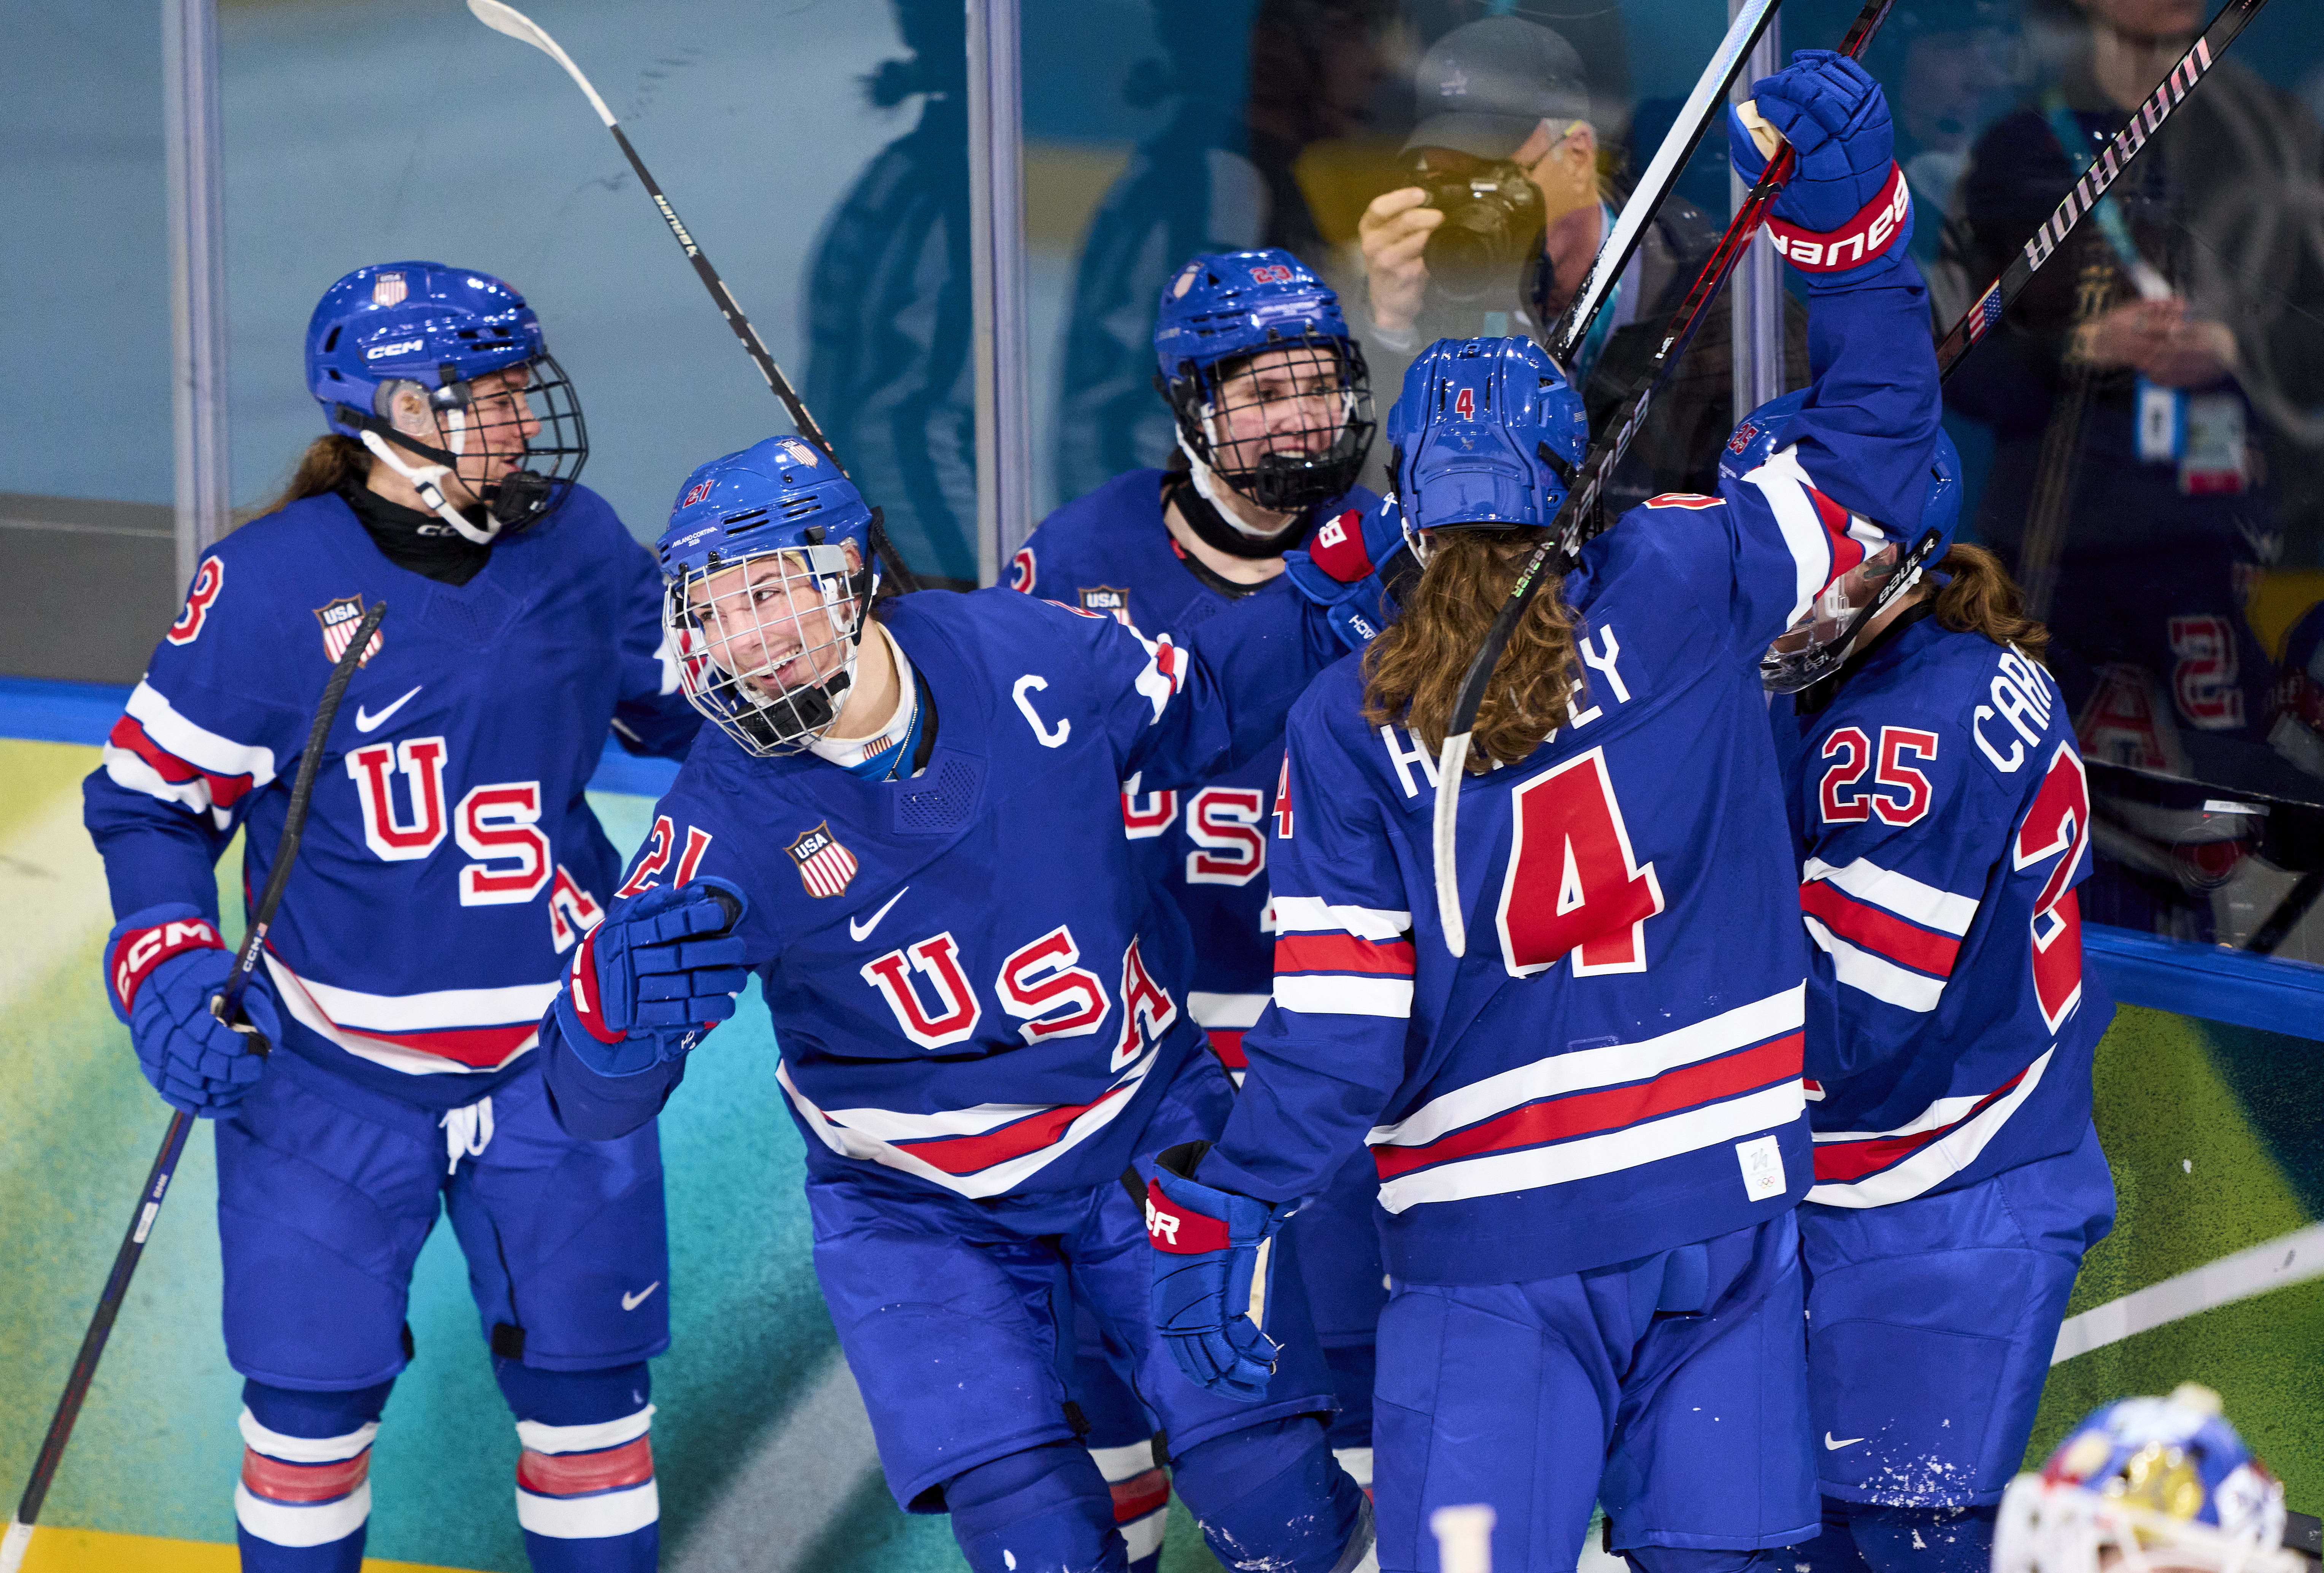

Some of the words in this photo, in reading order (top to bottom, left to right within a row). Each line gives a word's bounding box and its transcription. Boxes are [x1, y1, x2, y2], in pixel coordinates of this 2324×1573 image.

[2024, 37, 2211, 271] WARRIOR
[1249, 264, 1294, 284] 23
[367, 339, 423, 359] CCM
[1455, 388, 1475, 420] 4
[1728, 423, 1759, 455] 25
[682, 479, 715, 509] 21
[323, 602, 359, 625] USA
[1087, 592, 1121, 607] USA
[1348, 614, 1377, 639] ACH
[1012, 674, 1071, 748] C
[1380, 624, 1631, 798] HEY
[1272, 748, 1293, 839] 4
[1820, 726, 1939, 826] 25
[345, 736, 605, 954] USA
[614, 815, 713, 899] 21
[794, 833, 828, 860] USA
[1495, 745, 1664, 978] 4
[117, 922, 213, 1006] CCM
[242, 936, 263, 972] CCM
[860, 924, 1177, 1073] USA
